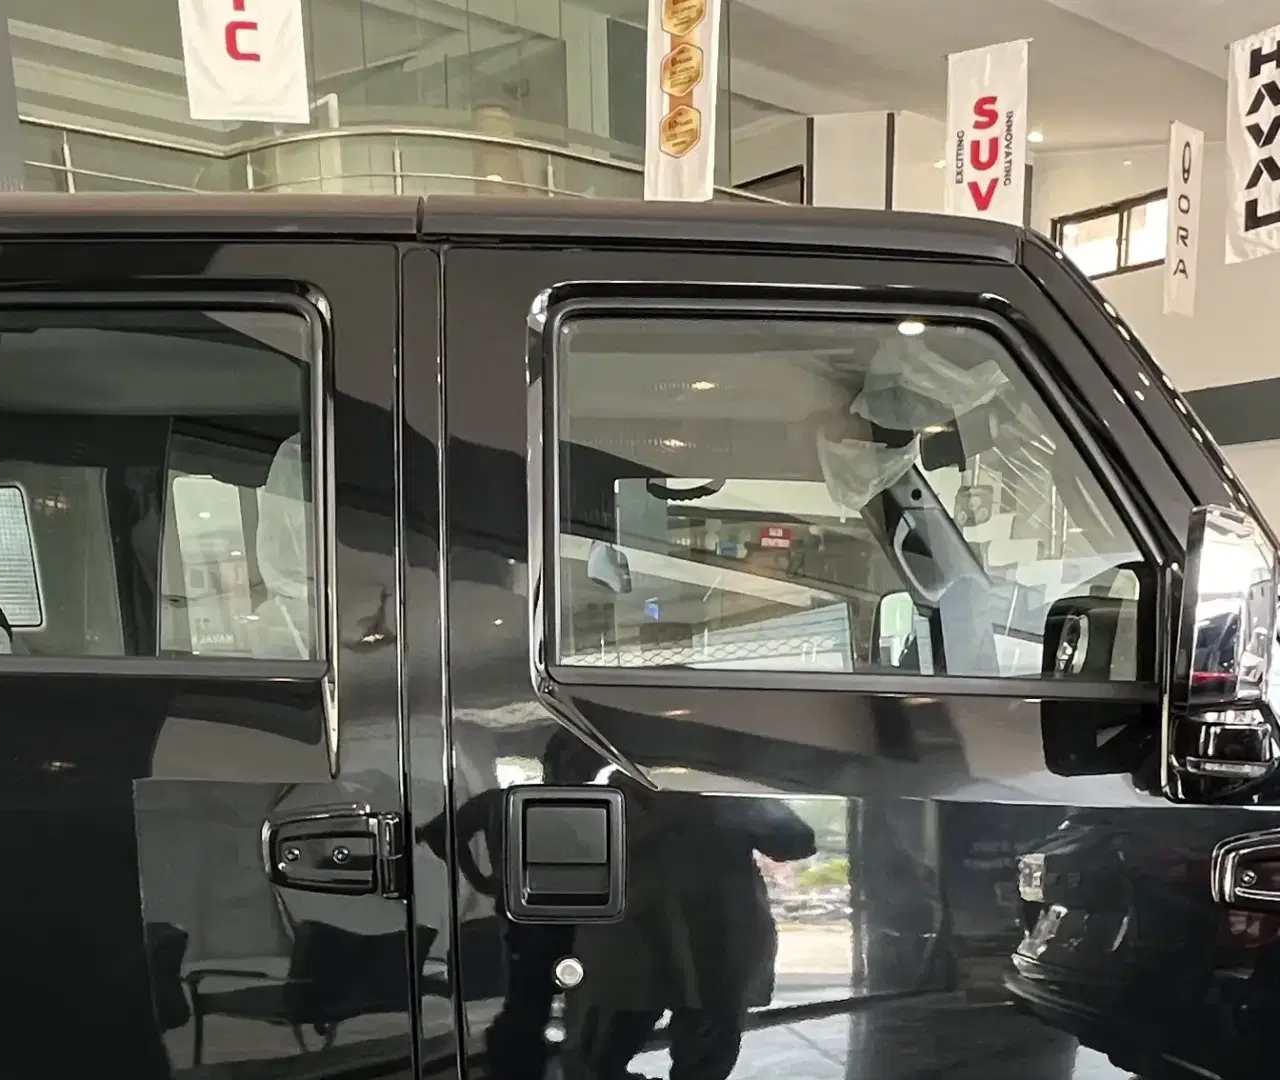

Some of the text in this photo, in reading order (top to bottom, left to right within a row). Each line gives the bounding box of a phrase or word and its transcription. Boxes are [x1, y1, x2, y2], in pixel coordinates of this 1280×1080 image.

[955, 130, 965, 184] EXCITING
[967, 96, 999, 211] SUV
[1003, 110, 1014, 187] INNOVATING
[1173, 194, 1191, 279] ORA
